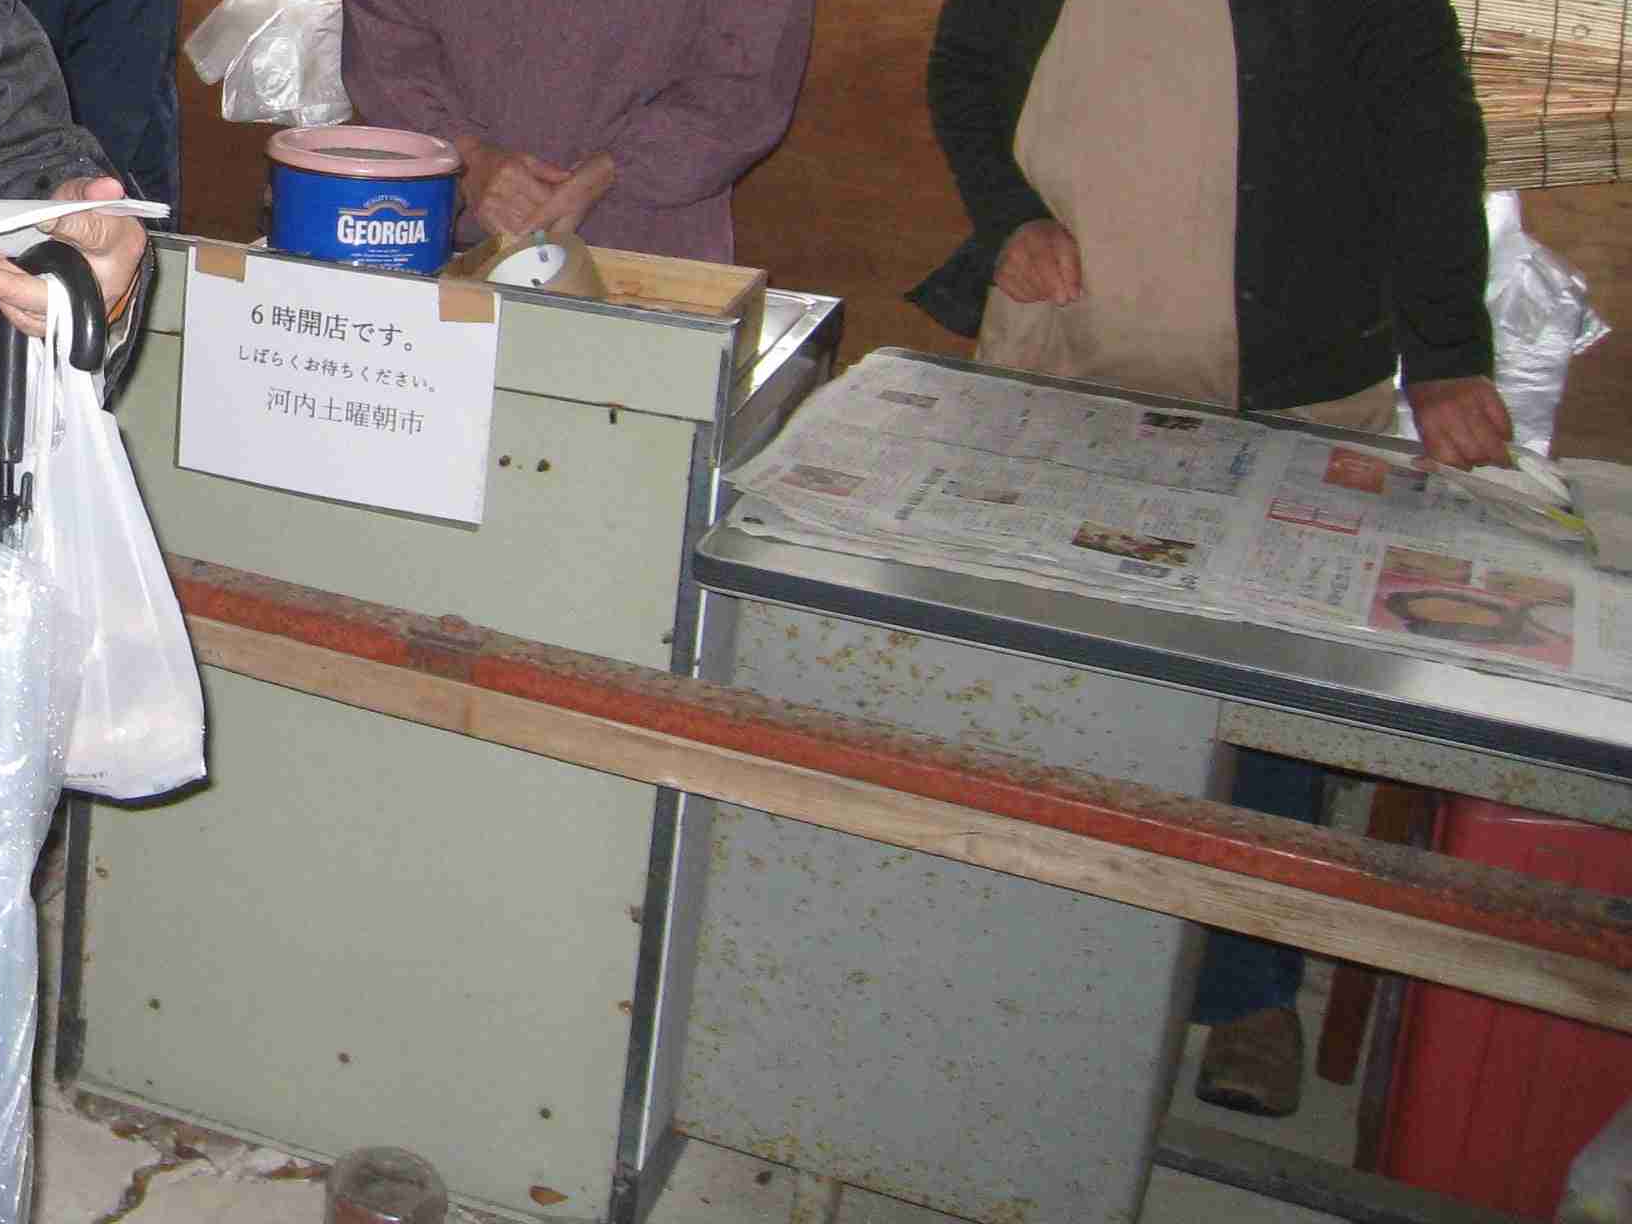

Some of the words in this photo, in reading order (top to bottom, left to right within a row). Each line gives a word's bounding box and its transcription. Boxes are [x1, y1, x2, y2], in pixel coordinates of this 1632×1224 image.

[337, 214, 426, 245] GEORGIA
[267, 386, 425, 436] 河内土曜朝市
